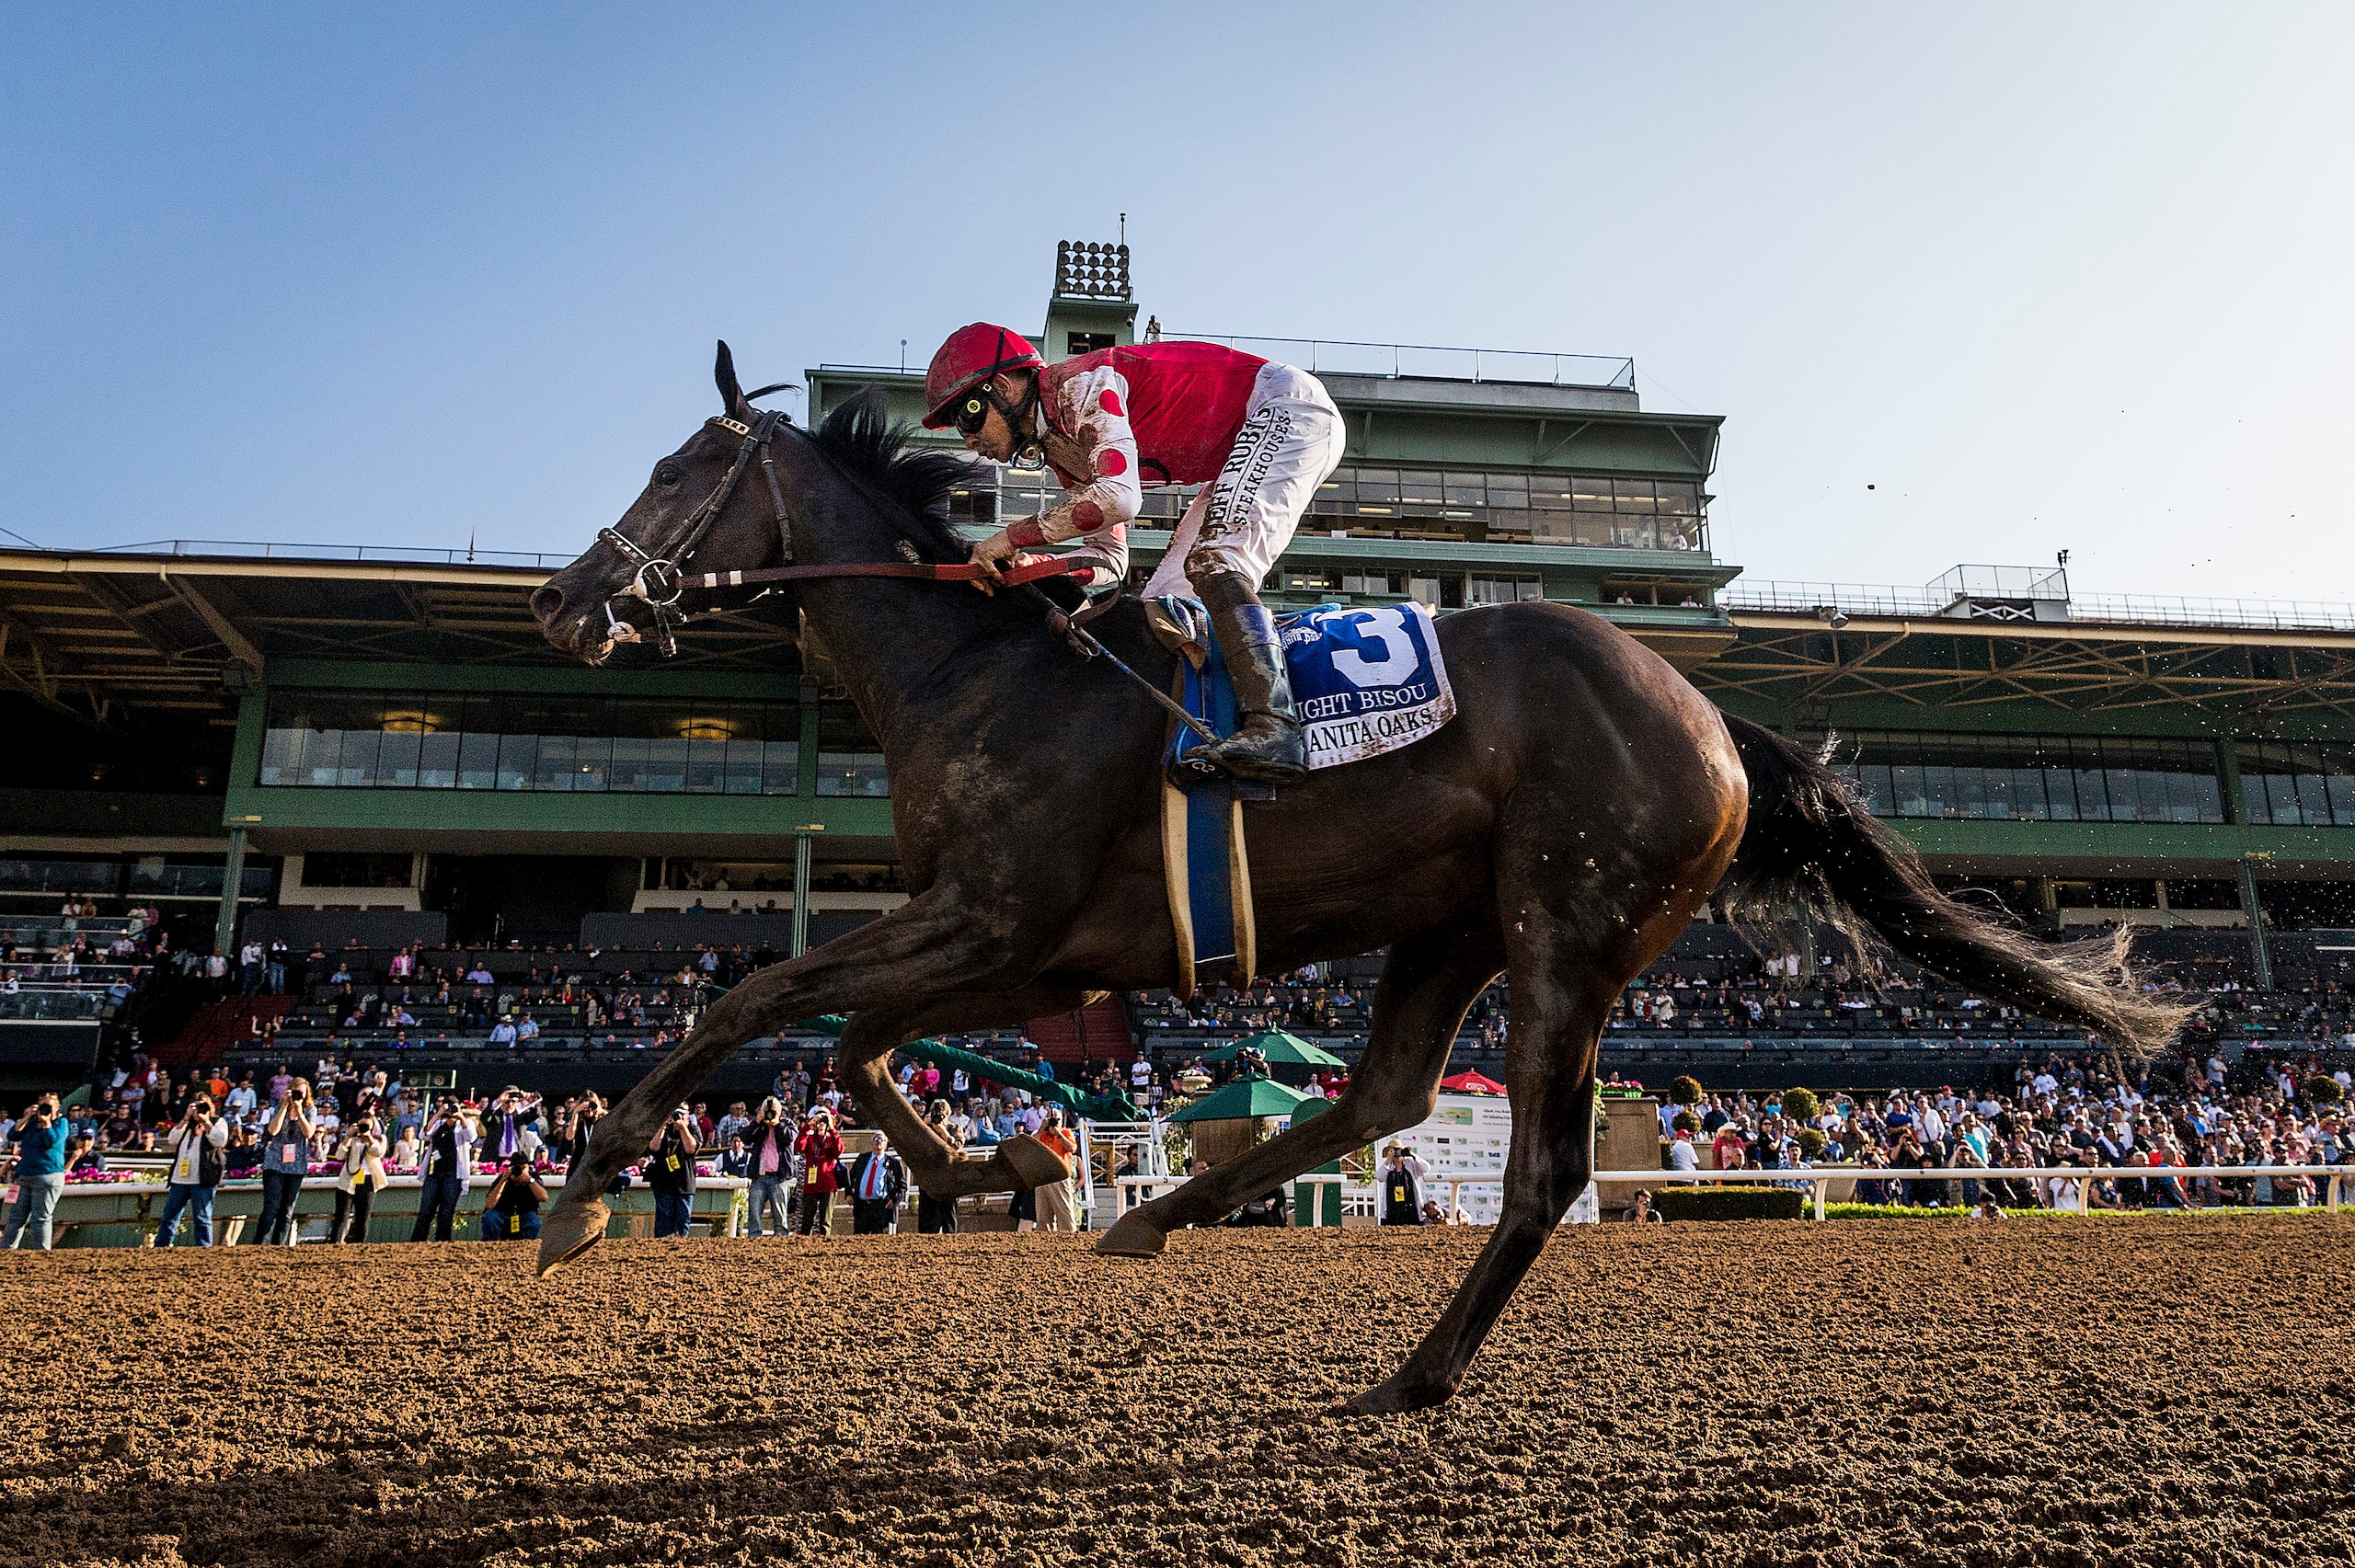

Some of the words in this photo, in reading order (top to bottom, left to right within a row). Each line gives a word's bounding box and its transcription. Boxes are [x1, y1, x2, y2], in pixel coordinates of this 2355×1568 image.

[1207, 484, 1235, 531] JEFF
[1223, 407, 1271, 474] RUBY'S
[1315, 608, 1419, 688] 3
[1357, 683, 1428, 711] BISOU
[1309, 720, 1375, 753] ANITA
[1377, 707, 1433, 738] OAKS
